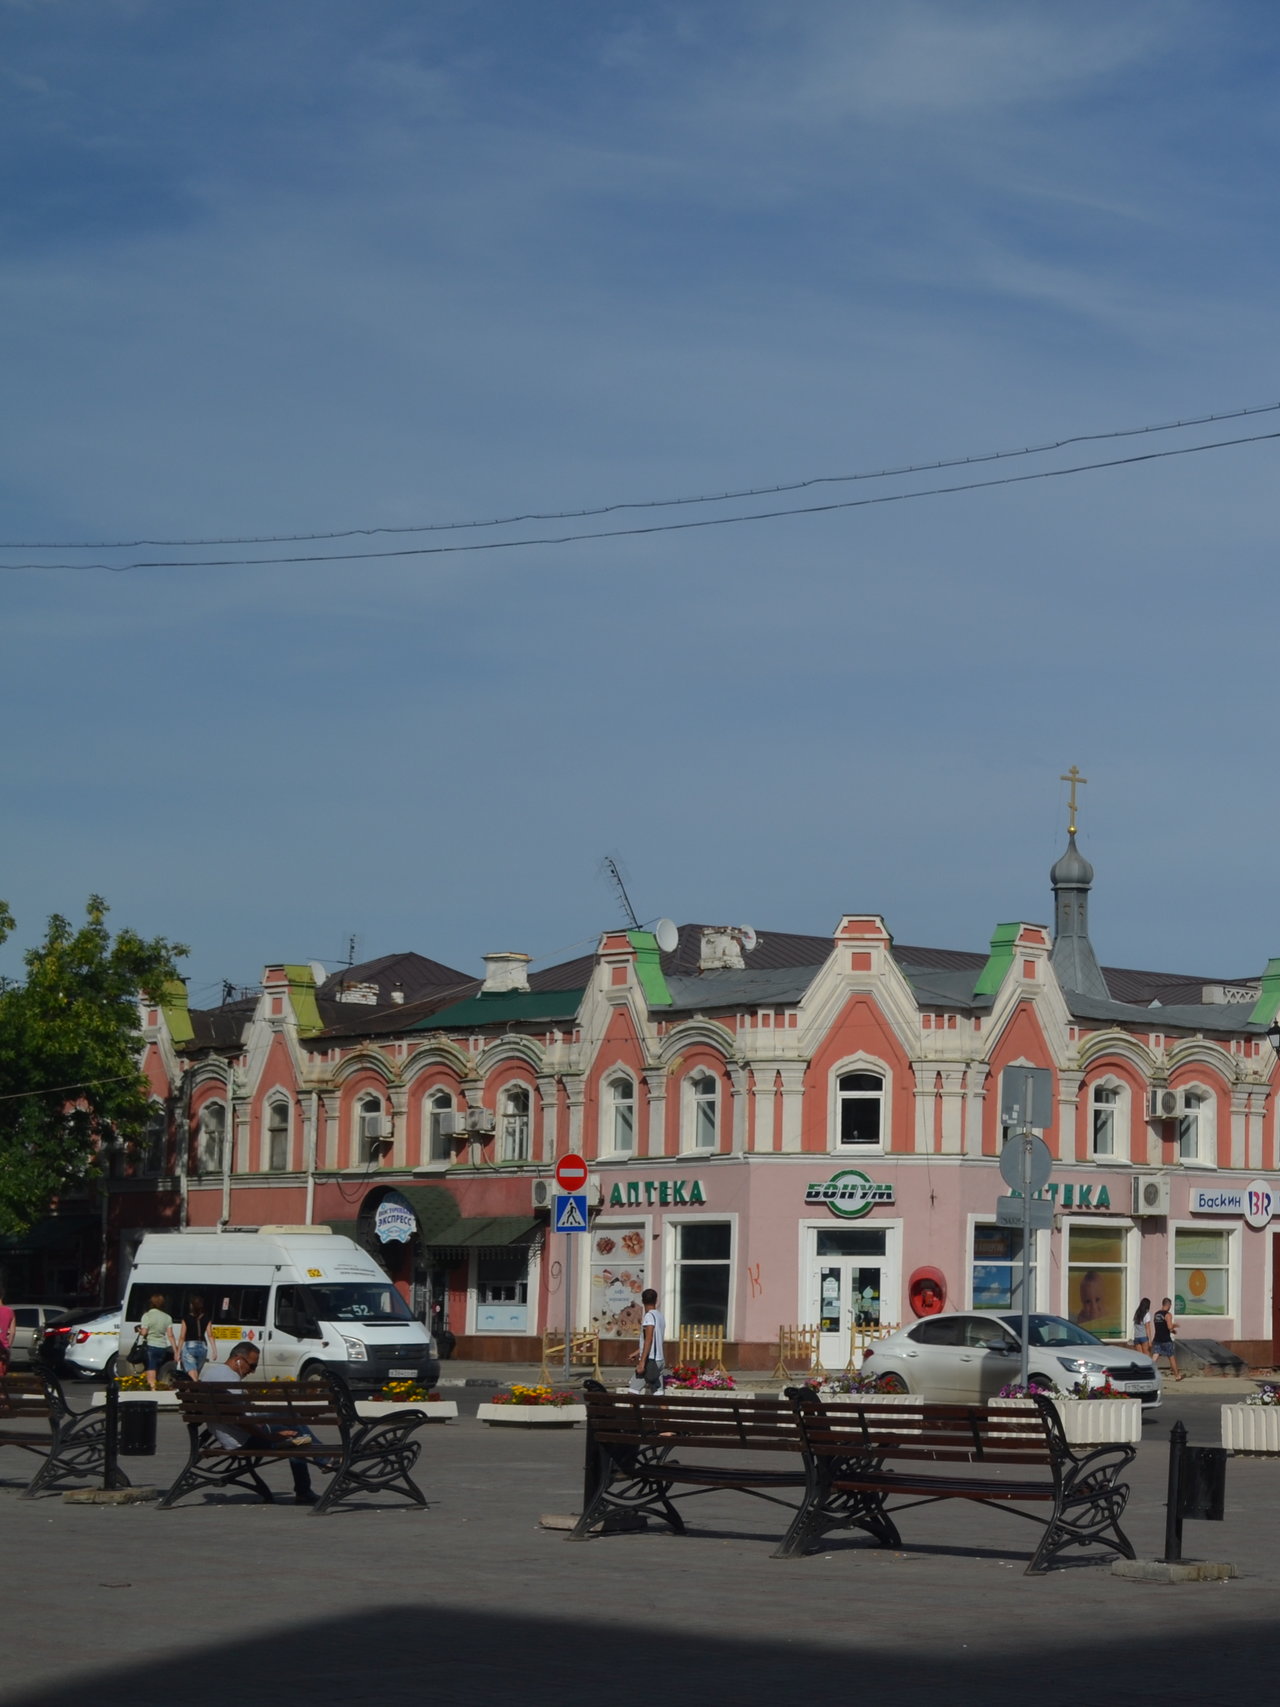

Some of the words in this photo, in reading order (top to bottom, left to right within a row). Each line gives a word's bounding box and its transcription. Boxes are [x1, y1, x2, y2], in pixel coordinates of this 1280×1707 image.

[609, 1180, 706, 1204] АПТЕКА
[806, 1183, 893, 1200] БОНУМ
[1008, 1183, 1111, 1206] ТЕКА
[1198, 1193, 1241, 1208] Баскин
[378, 1214, 412, 1227] ЭКСПРЕСС
[352, 1305, 369, 1316] 52
